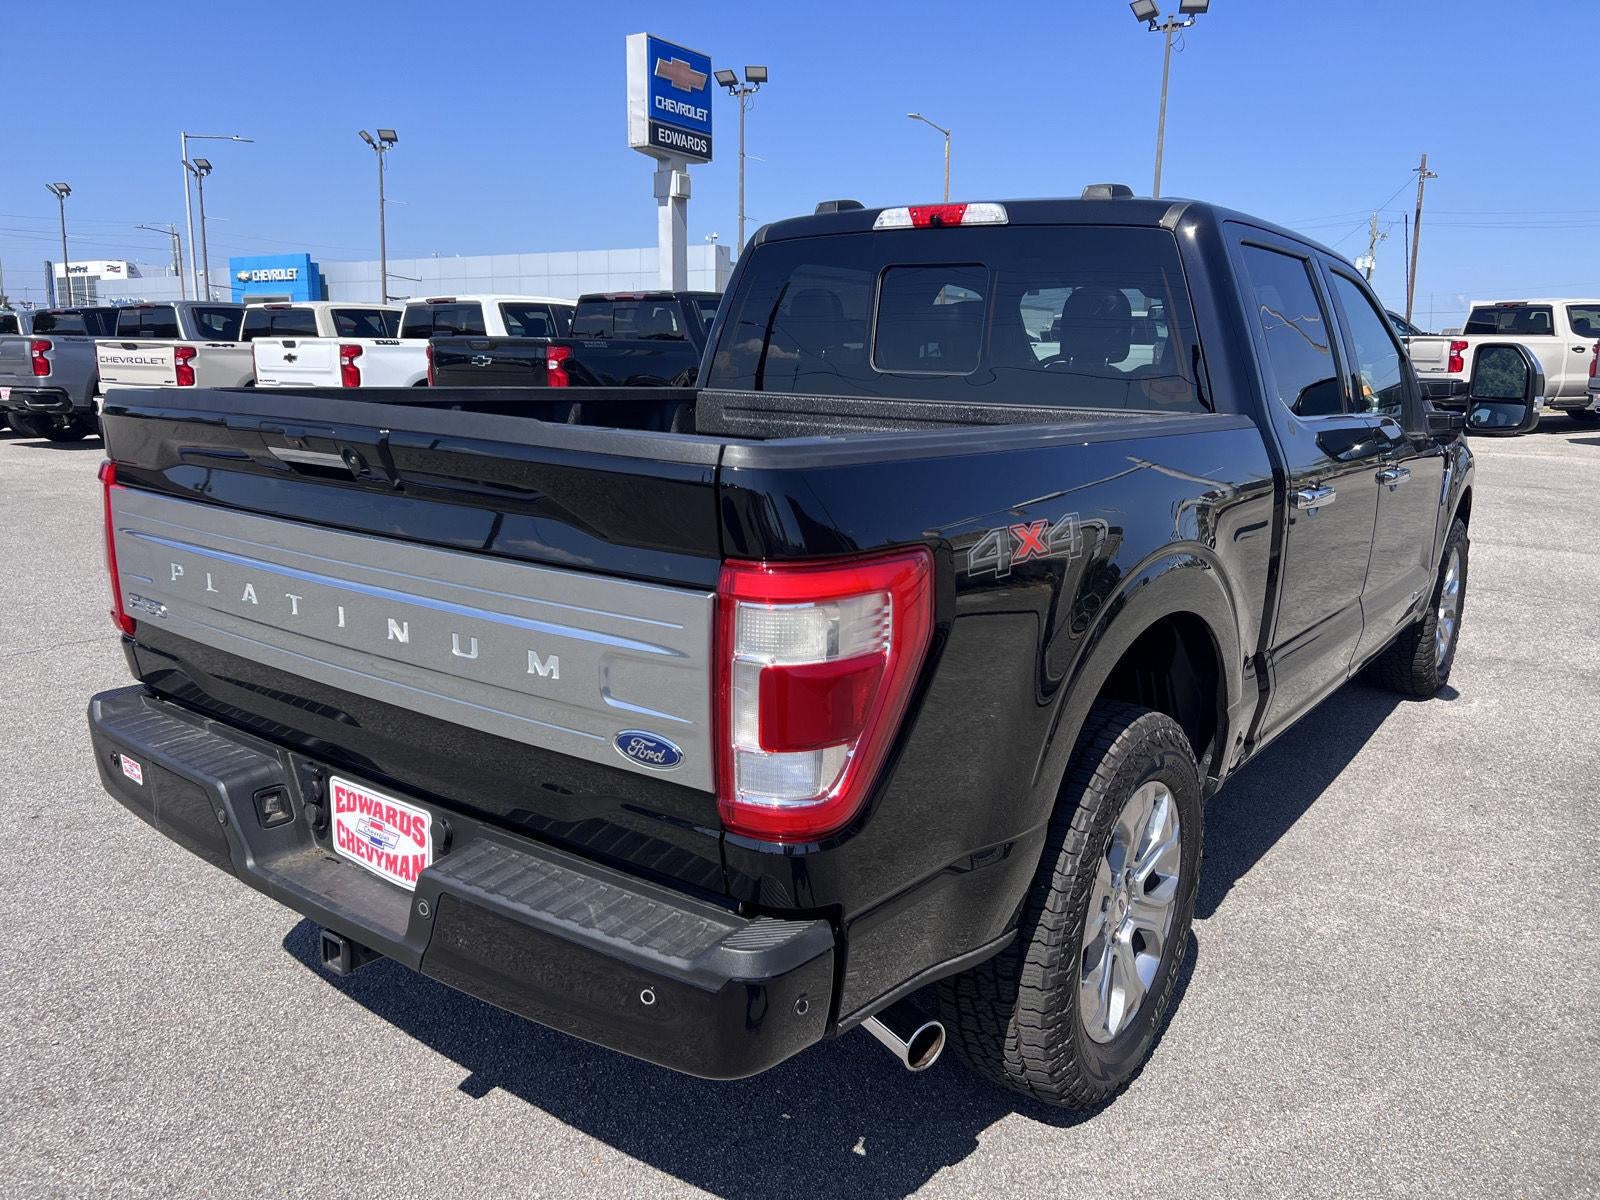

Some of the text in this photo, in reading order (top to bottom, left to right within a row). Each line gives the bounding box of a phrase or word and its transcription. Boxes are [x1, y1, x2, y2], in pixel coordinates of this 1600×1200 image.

[655, 95, 708, 121] CHEVROLET
[658, 128, 707, 152] EDWARDS
[252, 268, 298, 281] CHEVROLET
[100, 356, 166, 365] CHEVROLET
[170, 562, 560, 680] PLATINUM
[627, 737, 666, 763] Ford
[334, 785, 426, 848] EDWARDS
[336, 818, 426, 882] CHEVYMAN
